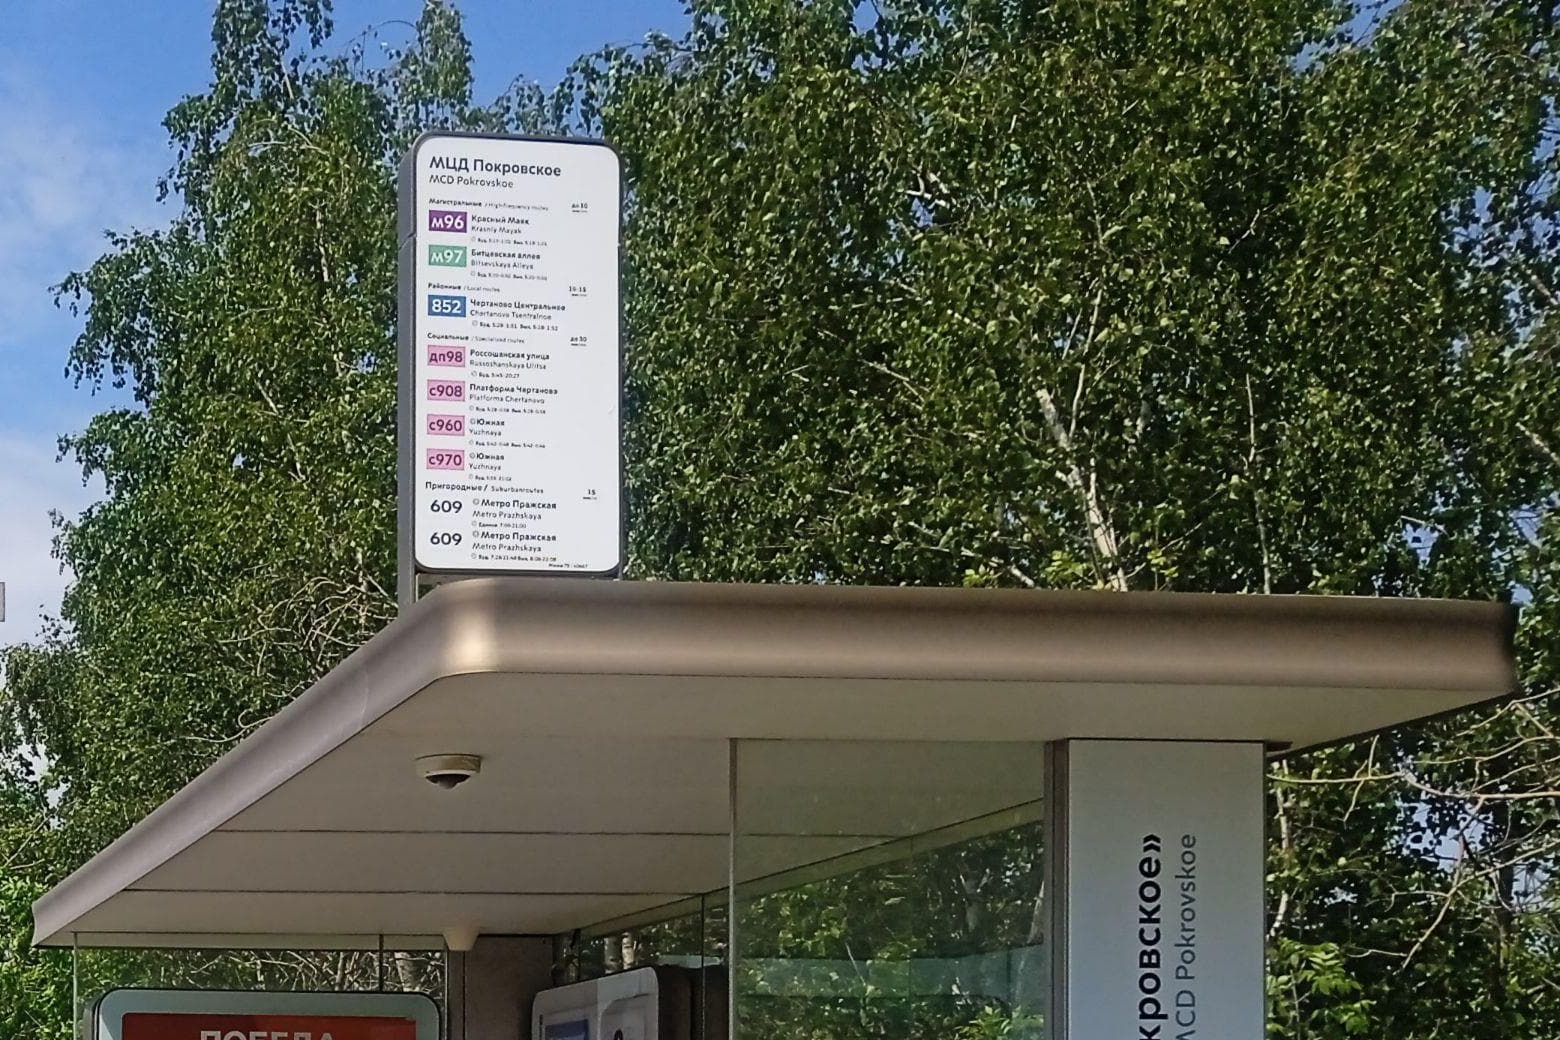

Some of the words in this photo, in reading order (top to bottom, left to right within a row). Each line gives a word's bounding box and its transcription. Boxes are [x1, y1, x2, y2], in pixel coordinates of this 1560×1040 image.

[429, 156, 469, 173] МЦД
[473, 159, 561, 176] Покровское
[429, 174, 454, 184] MCD
[457, 176, 514, 188] Pokrovskoe
[429, 198, 482, 207] Магистральные
[431, 214, 465, 229] м96
[471, 214, 506, 223] Красный
[507, 217, 530, 225] Маяк
[499, 226, 522, 234] Mayak
[430, 249, 463, 264] м97
[471, 249, 516, 259] Битцевская
[431, 298, 462, 314] 852
[470, 299, 512, 309] Чертаново
[514, 301, 566, 311] Центральное
[427, 332, 469, 341] Социальные
[429, 351, 463, 364] дп98
[470, 349, 525, 359] Россошанская
[526, 353, 550, 361] улица
[429, 384, 462, 397] с908
[469, 383, 515, 394] Платформа
[516, 385, 558, 395] Чертаново
[469, 394, 504, 402] Platforma
[505, 395, 545, 404] Chertanovo
[429, 419, 462, 432] с960
[476, 418, 505, 426] Южная
[428, 453, 462, 466] с970
[476, 452, 505, 460] Южная
[425, 482, 482, 491] Пригородные
[430, 499, 463, 514] 609
[481, 499, 511, 509] Метро
[512, 500, 557, 510] Пражская
[472, 510, 497, 518] Metro
[498, 511, 542, 520] Prazhskaya
[430, 532, 462, 546] 609
[480, 531, 511, 541] Метро
[512, 532, 557, 542] Пражская
[472, 543, 497, 551] Metro
[498, 543, 542, 552] Prazhskaya
[1175, 834, 1197, 981] Pokrovskoe
